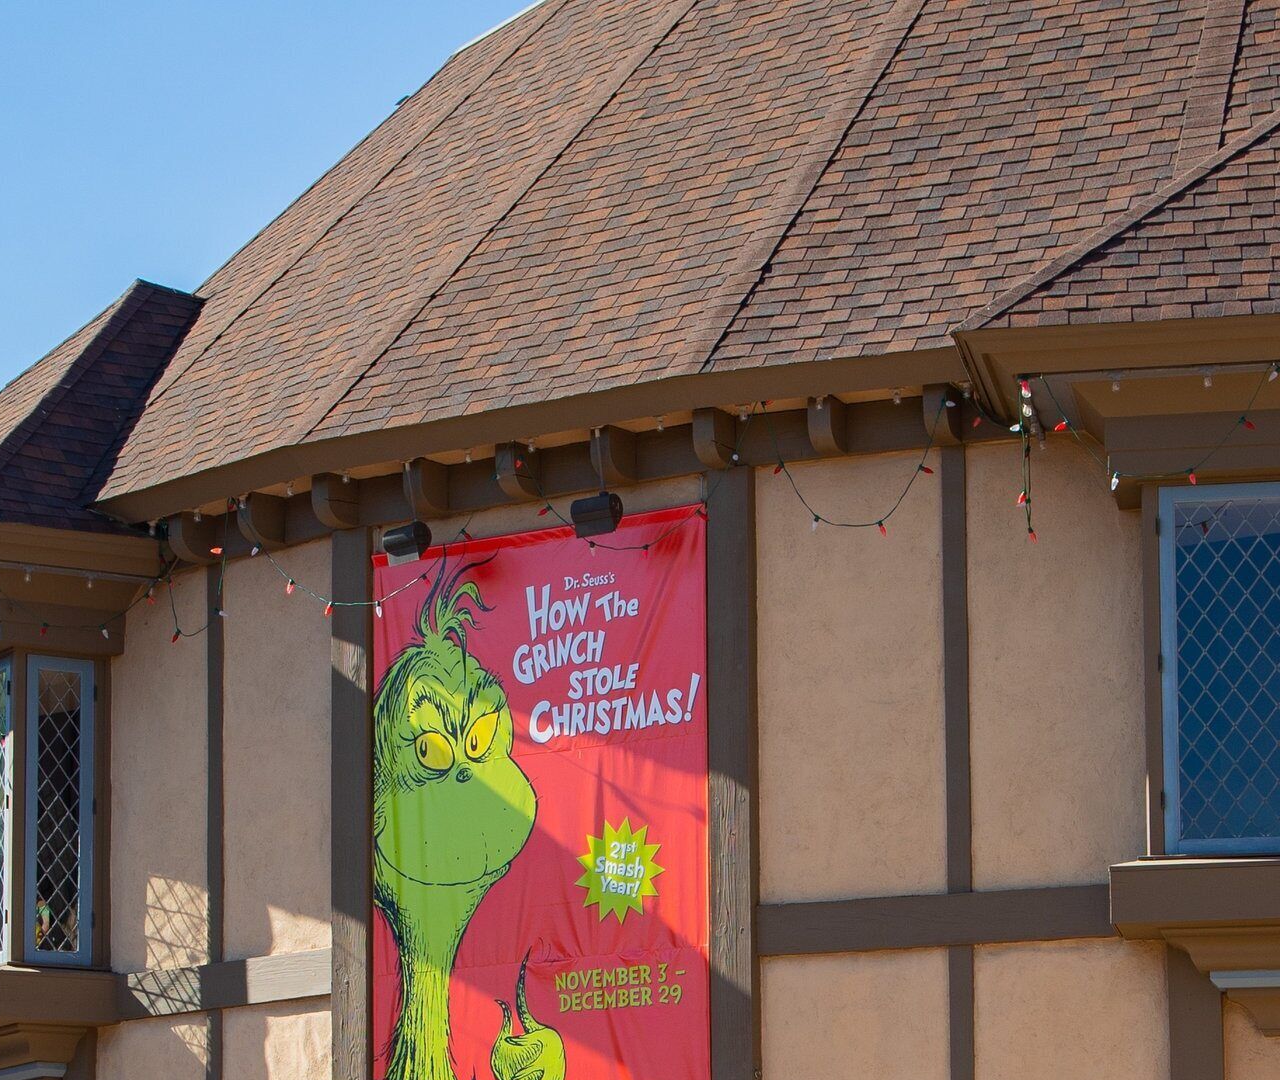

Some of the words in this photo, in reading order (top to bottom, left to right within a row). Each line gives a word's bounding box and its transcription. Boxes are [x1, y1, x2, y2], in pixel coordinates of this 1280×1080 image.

[564, 576, 580, 590] Dr.
[581, 572, 616, 588] Seuss's
[526, 584, 591, 641] HOW
[595, 591, 639, 622] The
[513, 629, 606, 684] GRINCH
[568, 662, 640, 700] STOLE
[529, 672, 701, 744] CHRISTMAS!
[610, 842, 638, 860] 21st
[595, 856, 646, 878] Smash
[600, 875, 640, 898] Year!
[554, 964, 652, 992] NOVEMBER
[658, 963, 668, 984] 3
[558, 987, 653, 1013] DECEMBER
[658, 984, 682, 1005] 29
